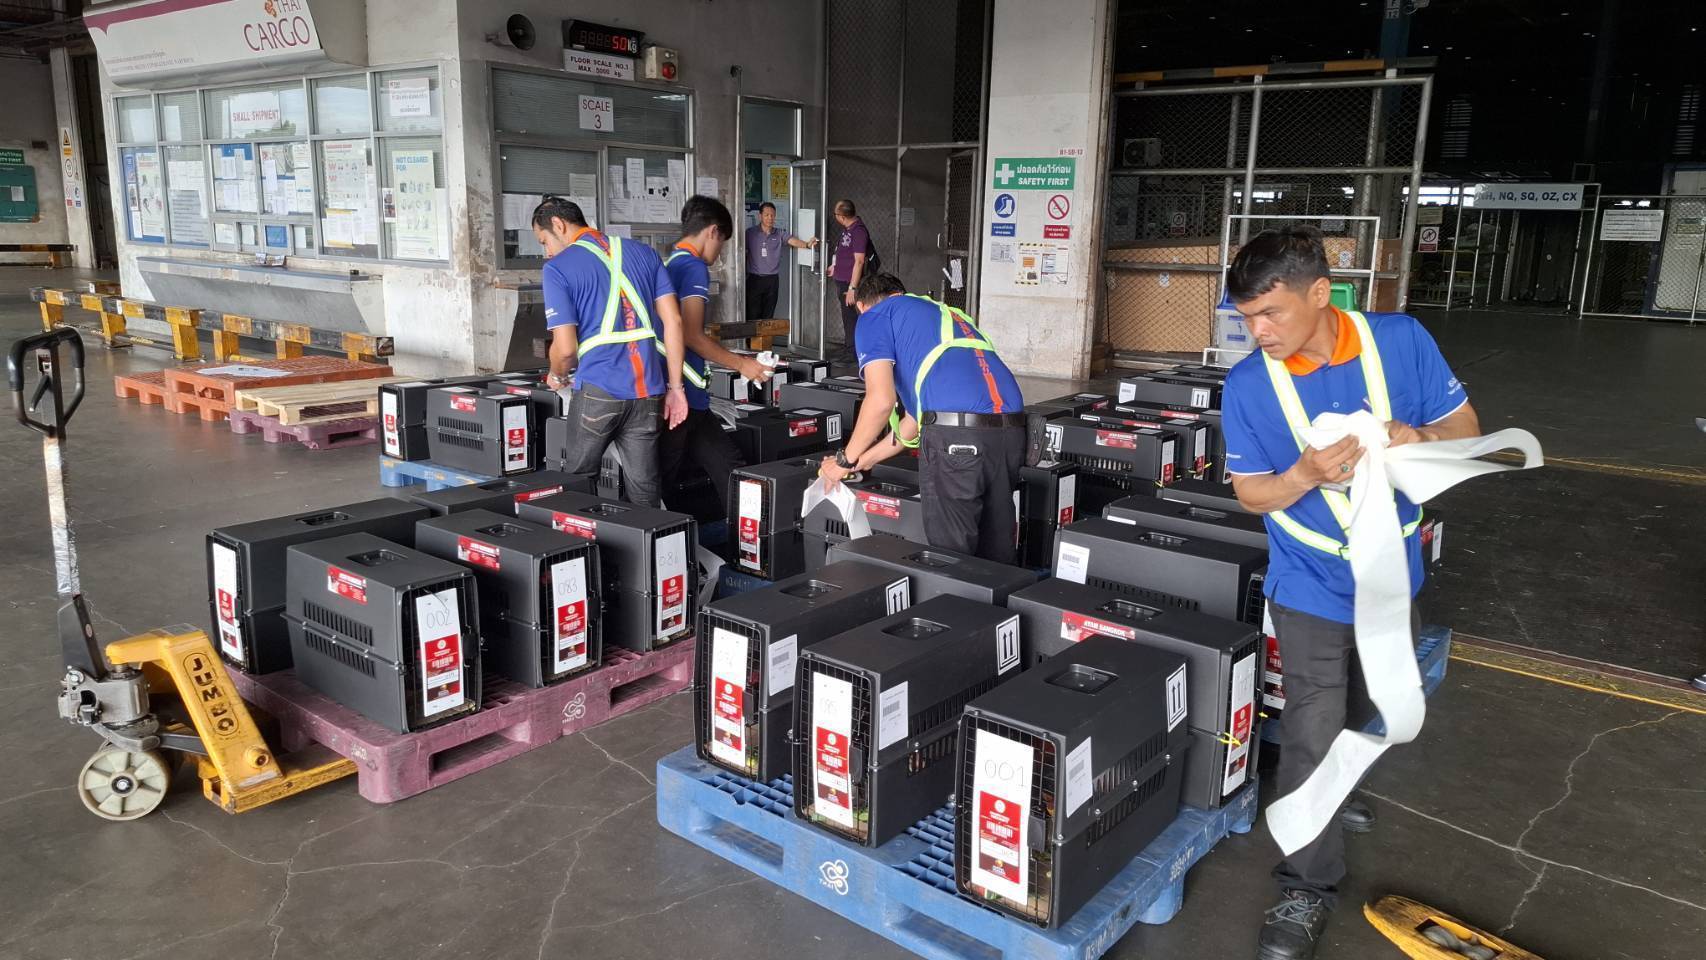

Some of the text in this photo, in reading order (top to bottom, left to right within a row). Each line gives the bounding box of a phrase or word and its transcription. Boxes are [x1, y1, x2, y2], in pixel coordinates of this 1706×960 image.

[243, 15, 311, 51] CARGO
[612, 35, 627, 51] 50
[570, 56, 591, 65] FLOOR
[593, 59, 612, 68] SCALE
[582, 99, 611, 112] SCALE
[232, 109, 279, 122] SMALL SHIPMENT
[594, 114, 602, 129] 3
[1018, 177, 1070, 186] SAFETY FIRST
[1499, 191, 1517, 202] NQ,
[1520, 191, 1538, 202] SQ,
[1541, 192, 1560, 202] OZ,
[1562, 192, 1578, 201] CX
[426, 609, 452, 629] 002
[1099, 624, 1126, 637] BANGKOK
[193, 657, 235, 731] JUMBO
[984, 759, 1024, 787] 001
